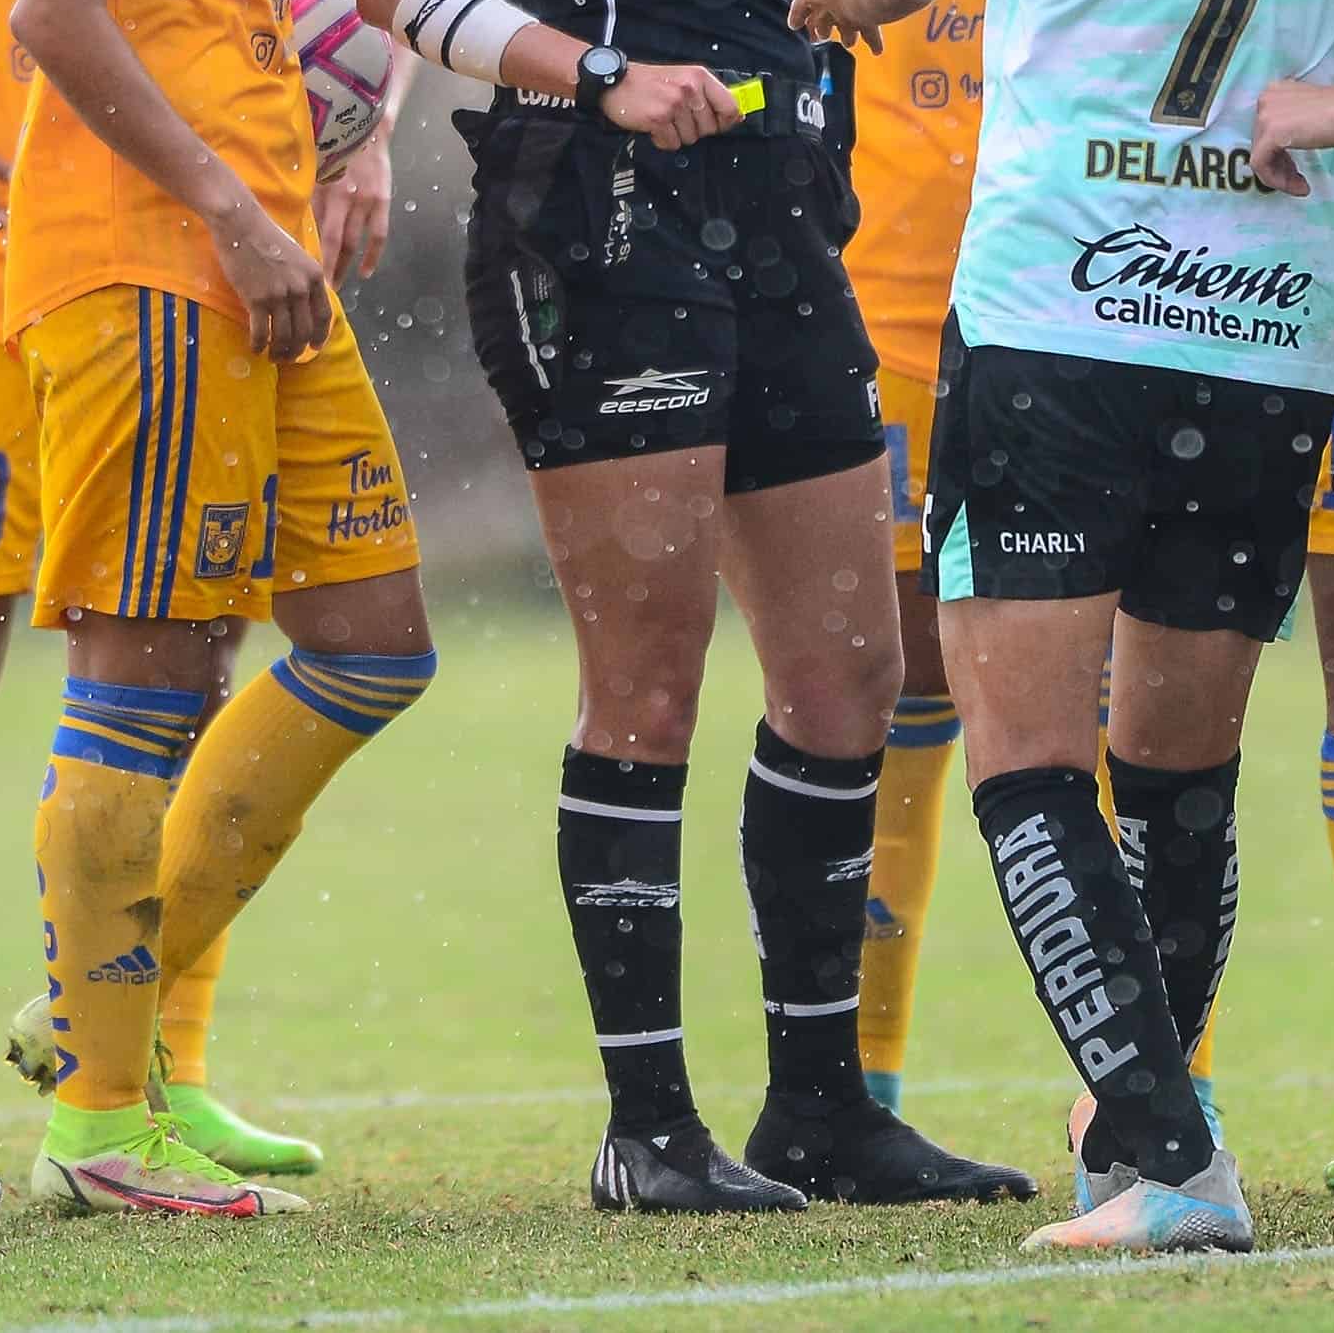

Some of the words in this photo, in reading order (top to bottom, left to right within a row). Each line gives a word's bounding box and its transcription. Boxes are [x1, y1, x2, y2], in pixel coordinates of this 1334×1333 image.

[1071, 222, 1313, 310] Caliente
[1094, 292, 1303, 350] caliente.mx
[598, 388, 710, 415] eescord
[341, 450, 394, 496] Tim
[999, 531, 1087, 554] CHARLY
[996, 812, 1140, 1083] PERDURA
